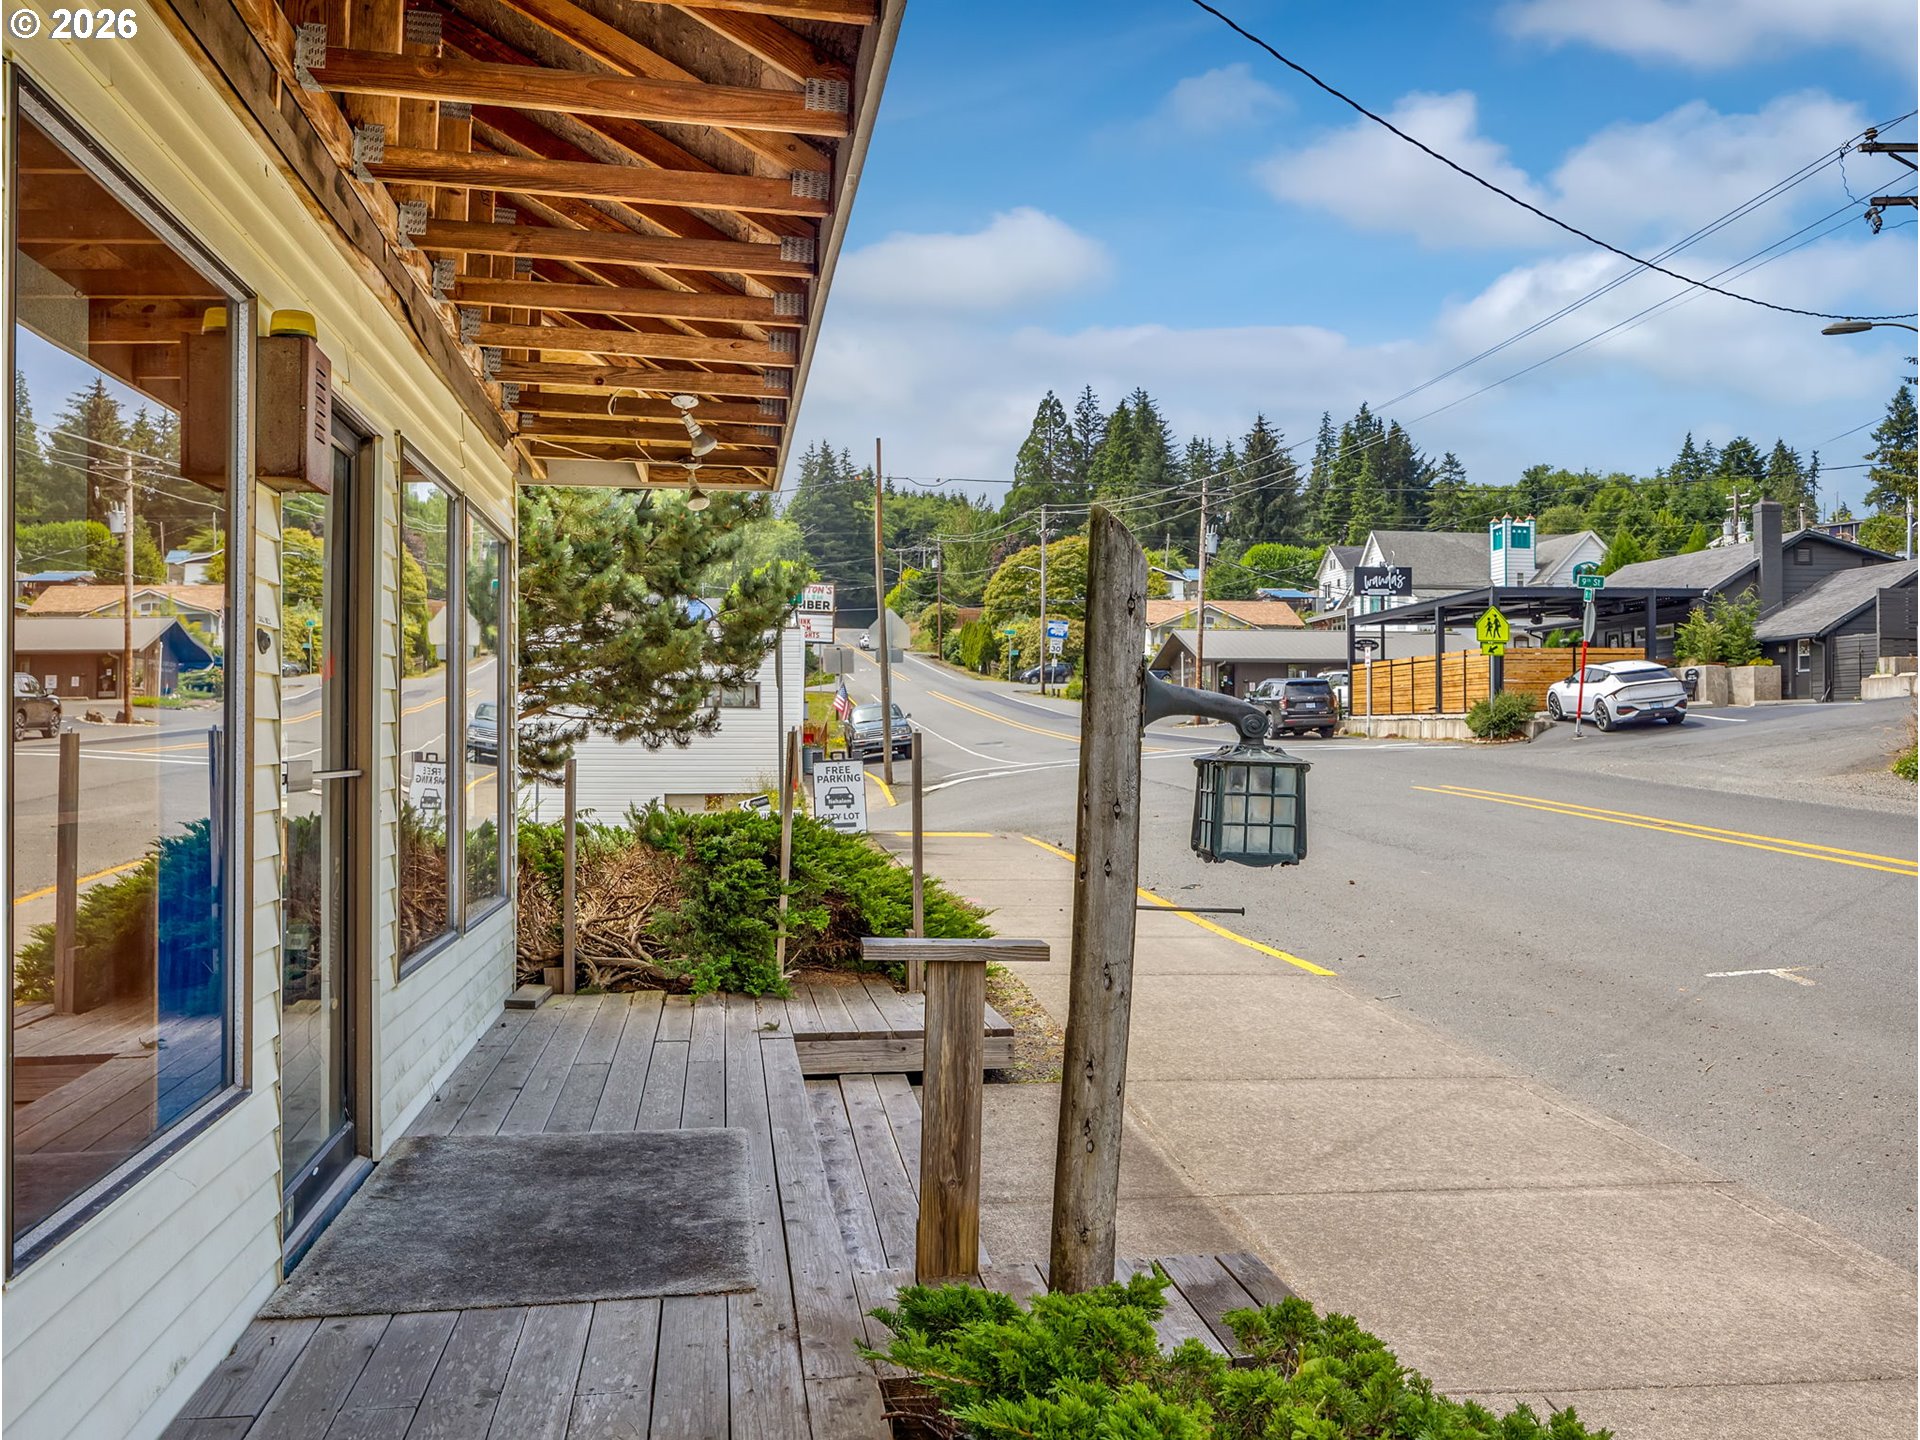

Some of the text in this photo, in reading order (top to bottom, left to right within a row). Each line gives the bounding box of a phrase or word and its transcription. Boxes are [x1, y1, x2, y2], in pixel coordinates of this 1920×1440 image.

[1050, 645, 1061, 653] 30
[825, 765, 851, 775] FREE
[817, 773, 861, 784] PARKING
[843, 812, 860, 820] LOT
